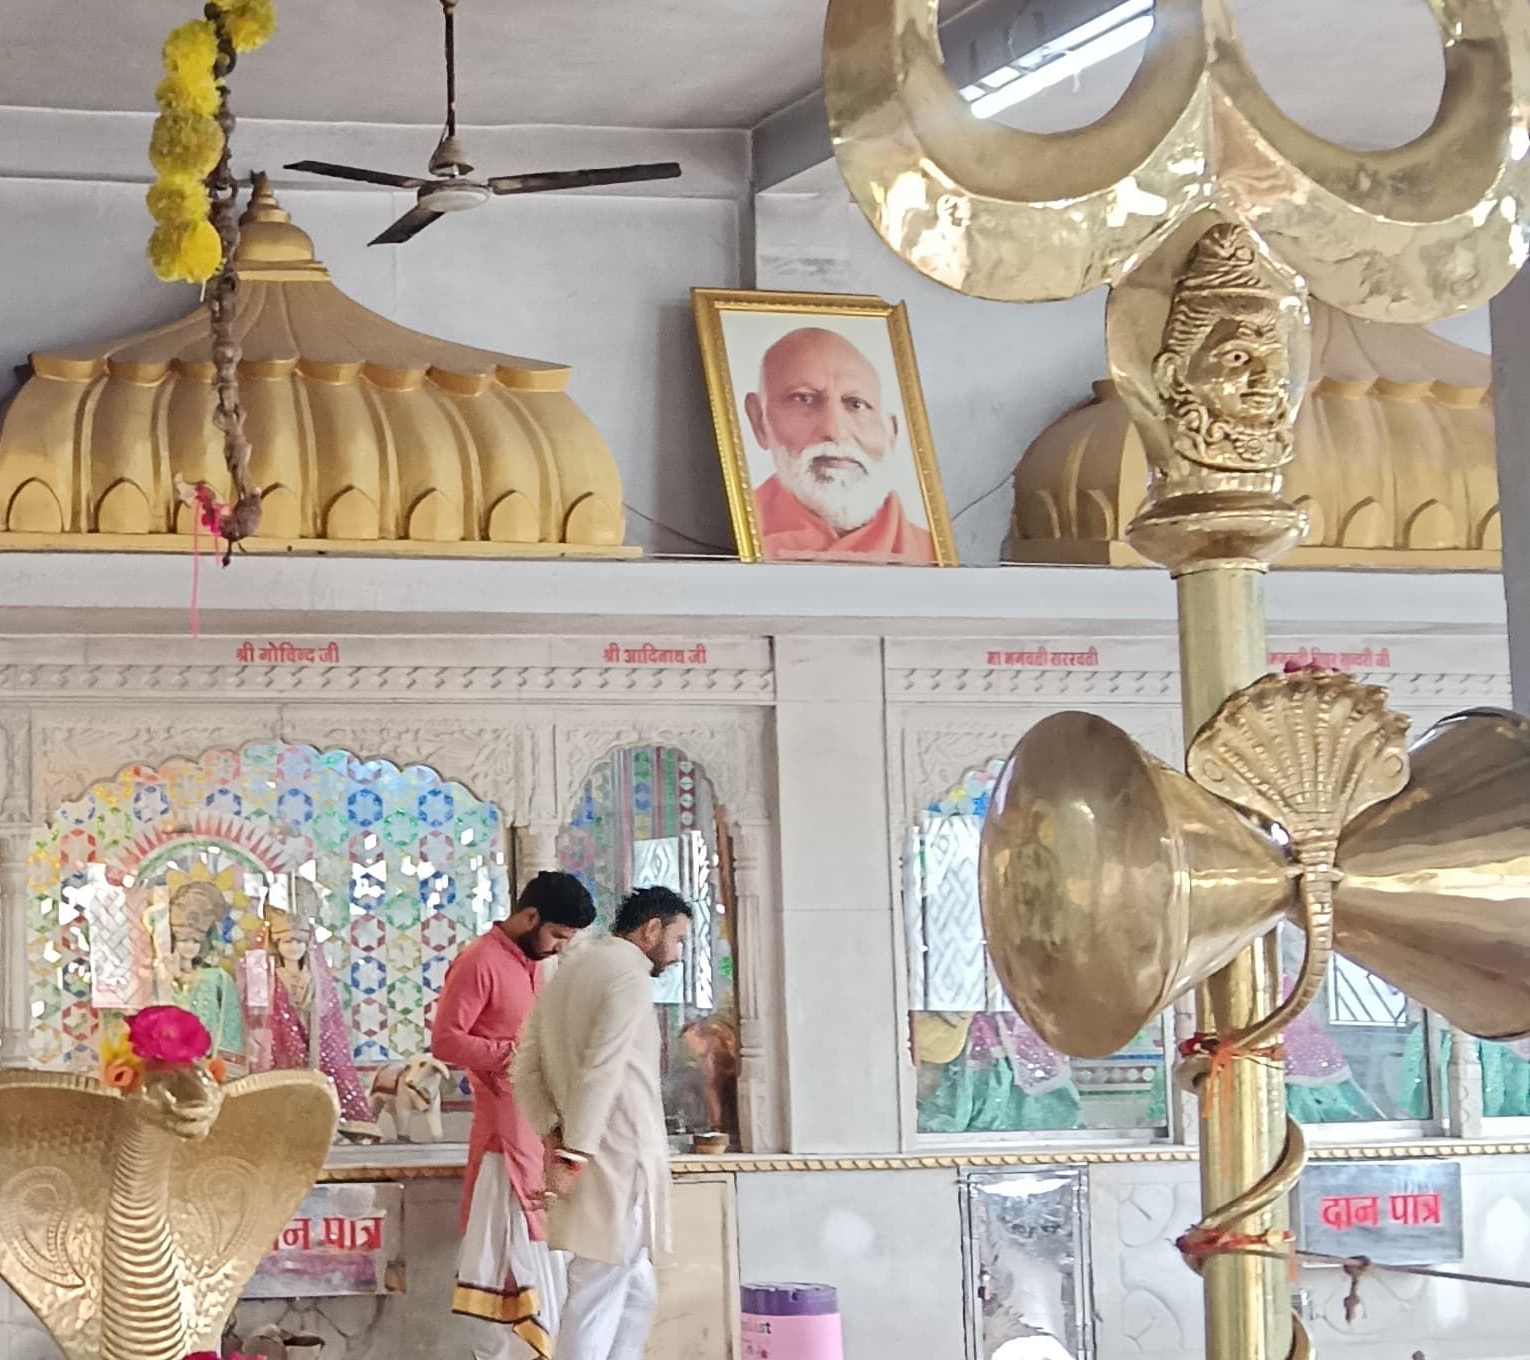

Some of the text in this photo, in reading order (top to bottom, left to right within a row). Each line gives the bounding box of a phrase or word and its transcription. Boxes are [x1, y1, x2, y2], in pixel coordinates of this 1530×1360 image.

[236, 641, 255, 663] श्री
[318, 641, 340, 663] जी
[603, 642, 620, 663] श्री
[687, 643, 706, 664] जी
[1321, 1193, 1441, 1231] दान पात्र
[323, 1216, 384, 1250] पात्र
